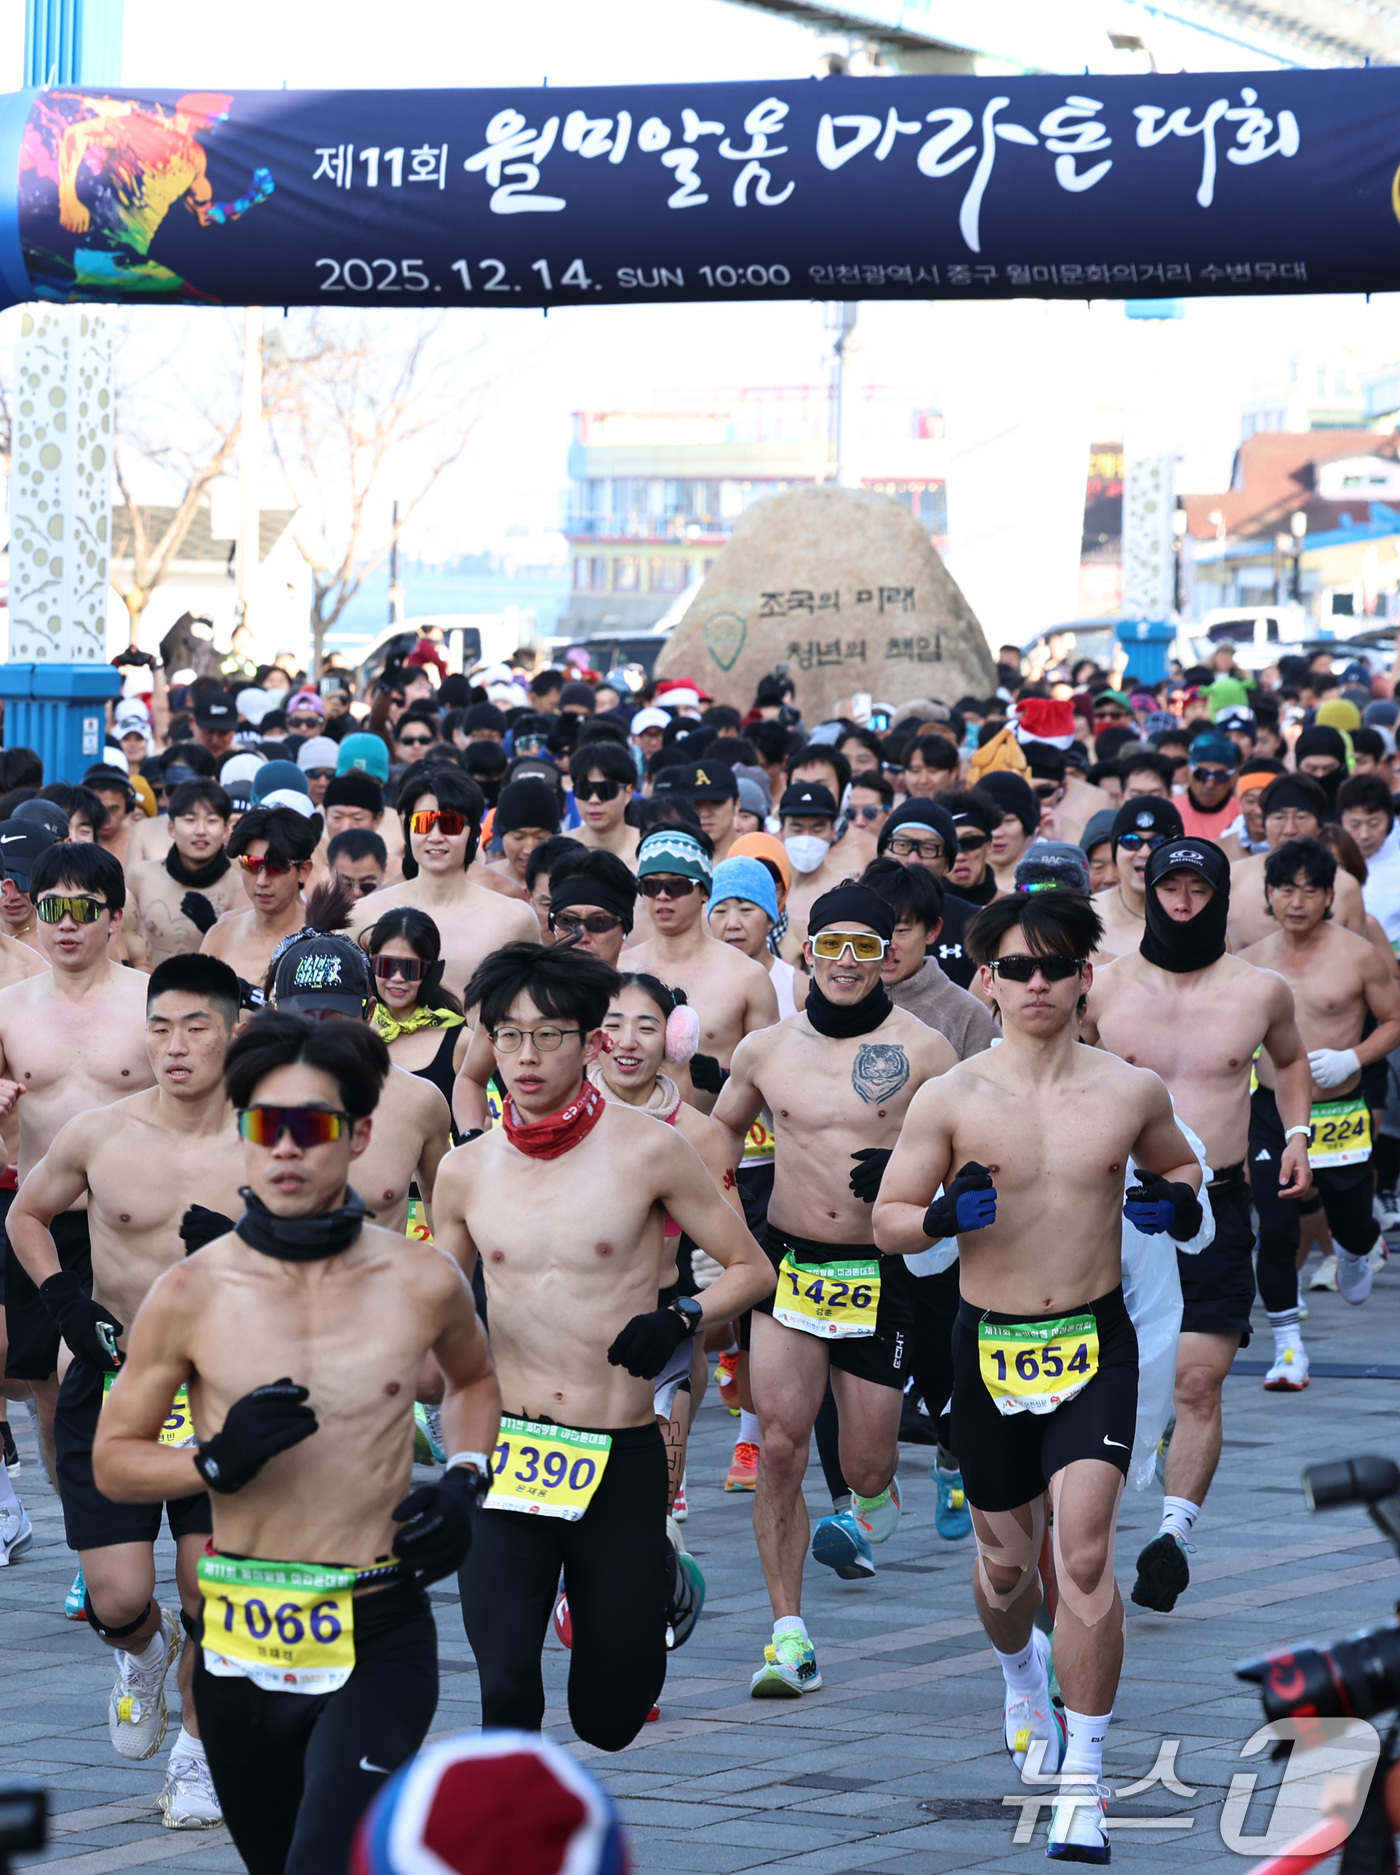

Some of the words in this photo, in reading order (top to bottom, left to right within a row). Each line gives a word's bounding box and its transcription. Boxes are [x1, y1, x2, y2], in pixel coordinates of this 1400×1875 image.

[313, 143, 449, 190] 제11회
[463, 97, 796, 215] 월미알몸
[617, 267, 685, 287] SUN
[699, 264, 791, 287] 10:00
[808, 263, 941, 286] 인천광역시
[946, 263, 999, 286] 중구
[1200, 260, 1308, 283] 수변무대
[759, 588, 841, 618] 조국의
[856, 586, 917, 613] 미래
[787, 638, 867, 670] 청년의
[885, 634, 943, 662] 책임
[1310, 1116, 1366, 1143] 1224
[787, 1272, 872, 1309] 1426
[990, 1343, 1091, 1381] 1654
[560, 1428, 607, 1445] 마라톤대회
[493, 1441, 596, 1491] 1390
[218, 1595, 342, 1645] 1066
